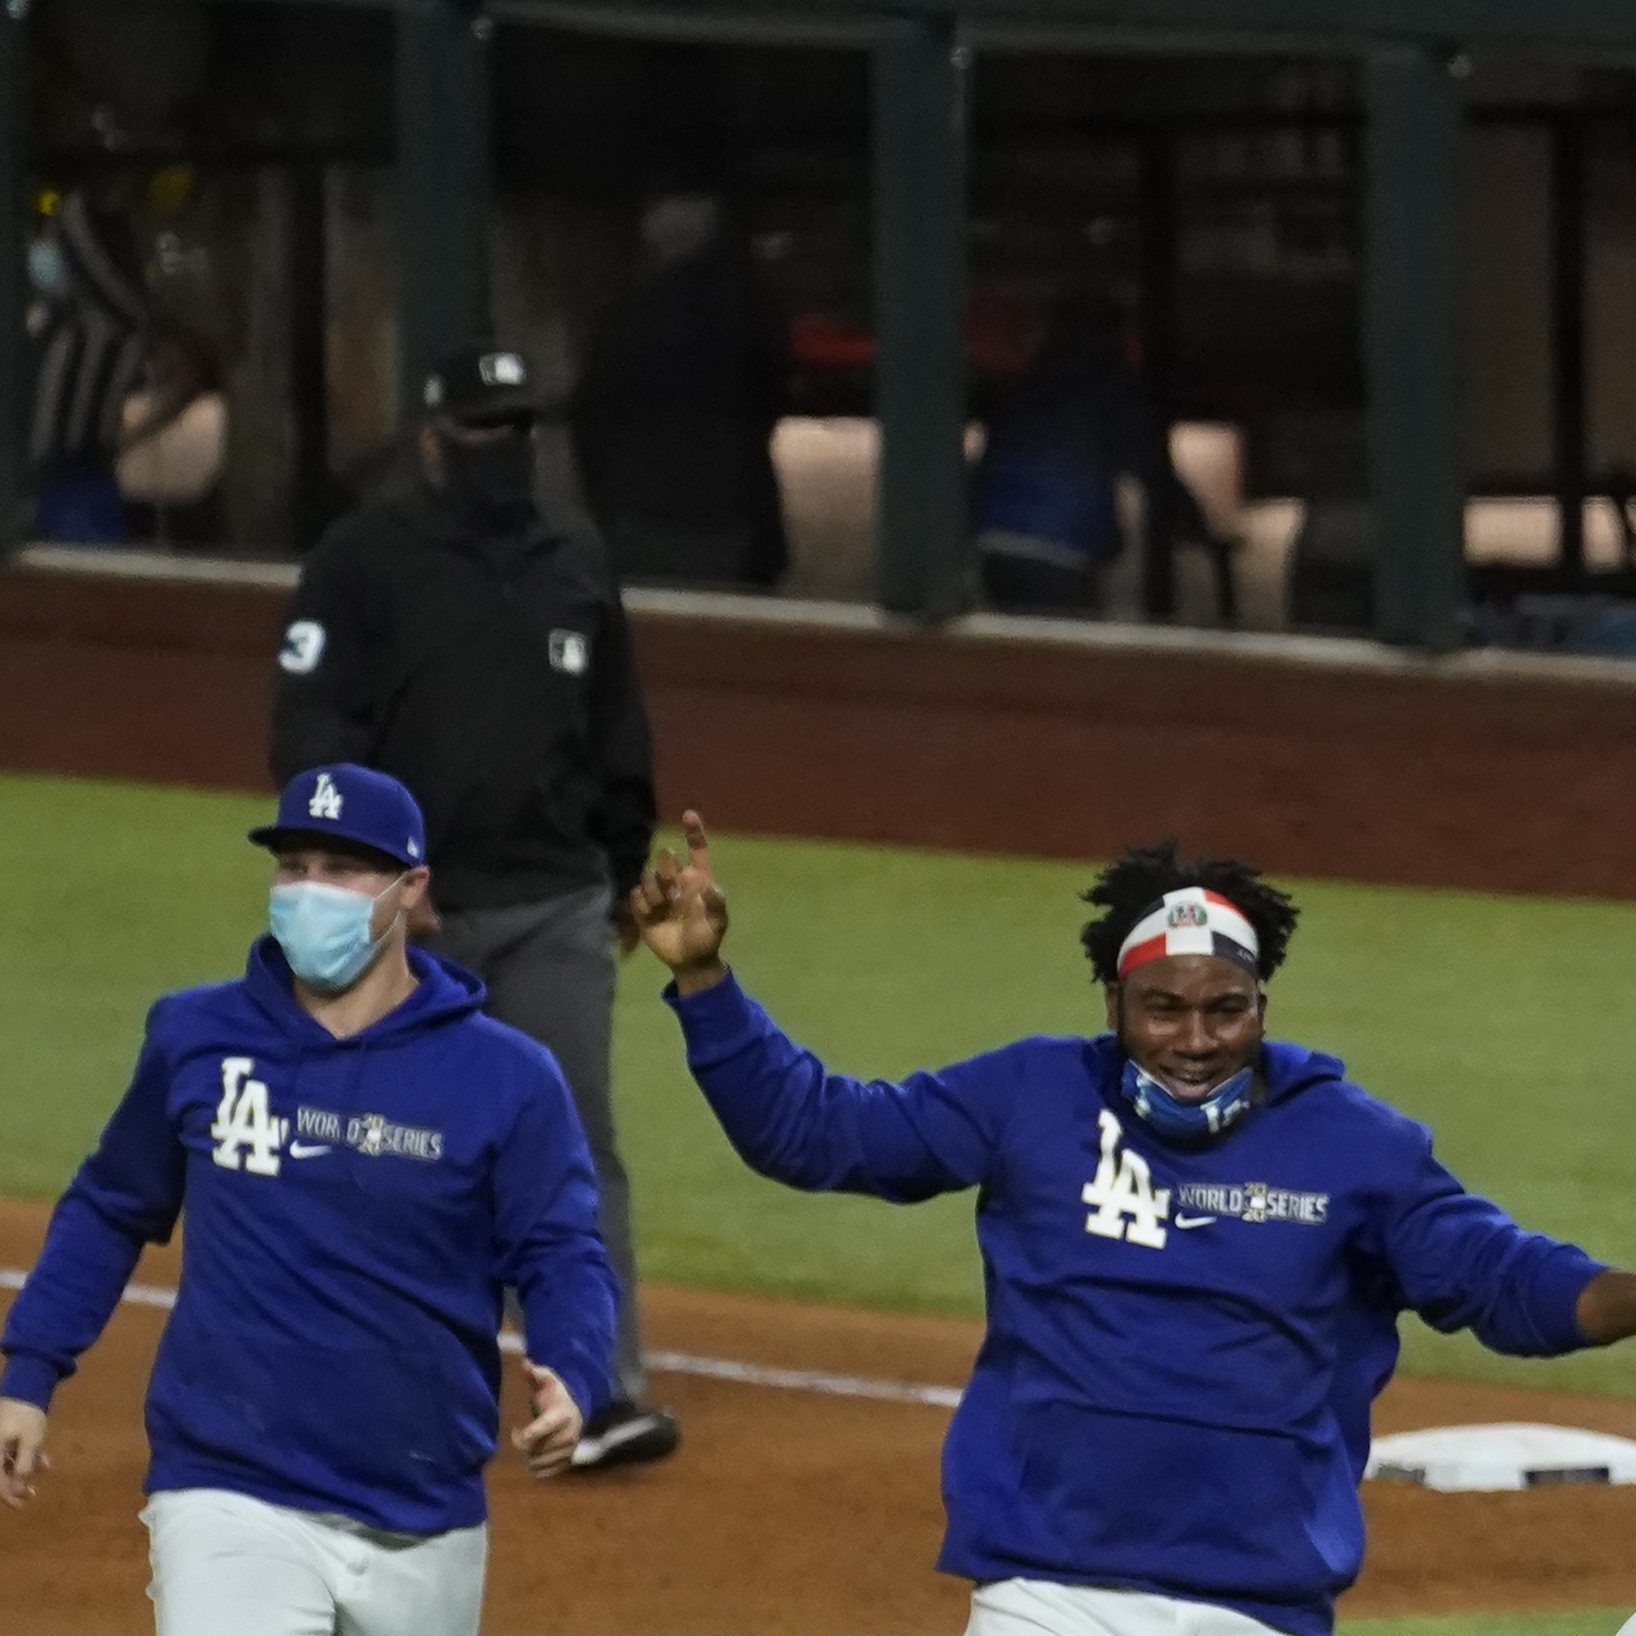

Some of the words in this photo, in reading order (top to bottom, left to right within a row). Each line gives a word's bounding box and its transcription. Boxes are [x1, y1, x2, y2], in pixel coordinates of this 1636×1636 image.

[277, 621, 326, 674] 3
[308, 773, 343, 820] LA
[212, 1057, 288, 1177] LA
[297, 1106, 361, 1144] WORD
[1081, 1108, 1171, 1249] LA
[1179, 1184, 1243, 1216] WORLD
[1266, 1190, 1329, 1225] SERIES
